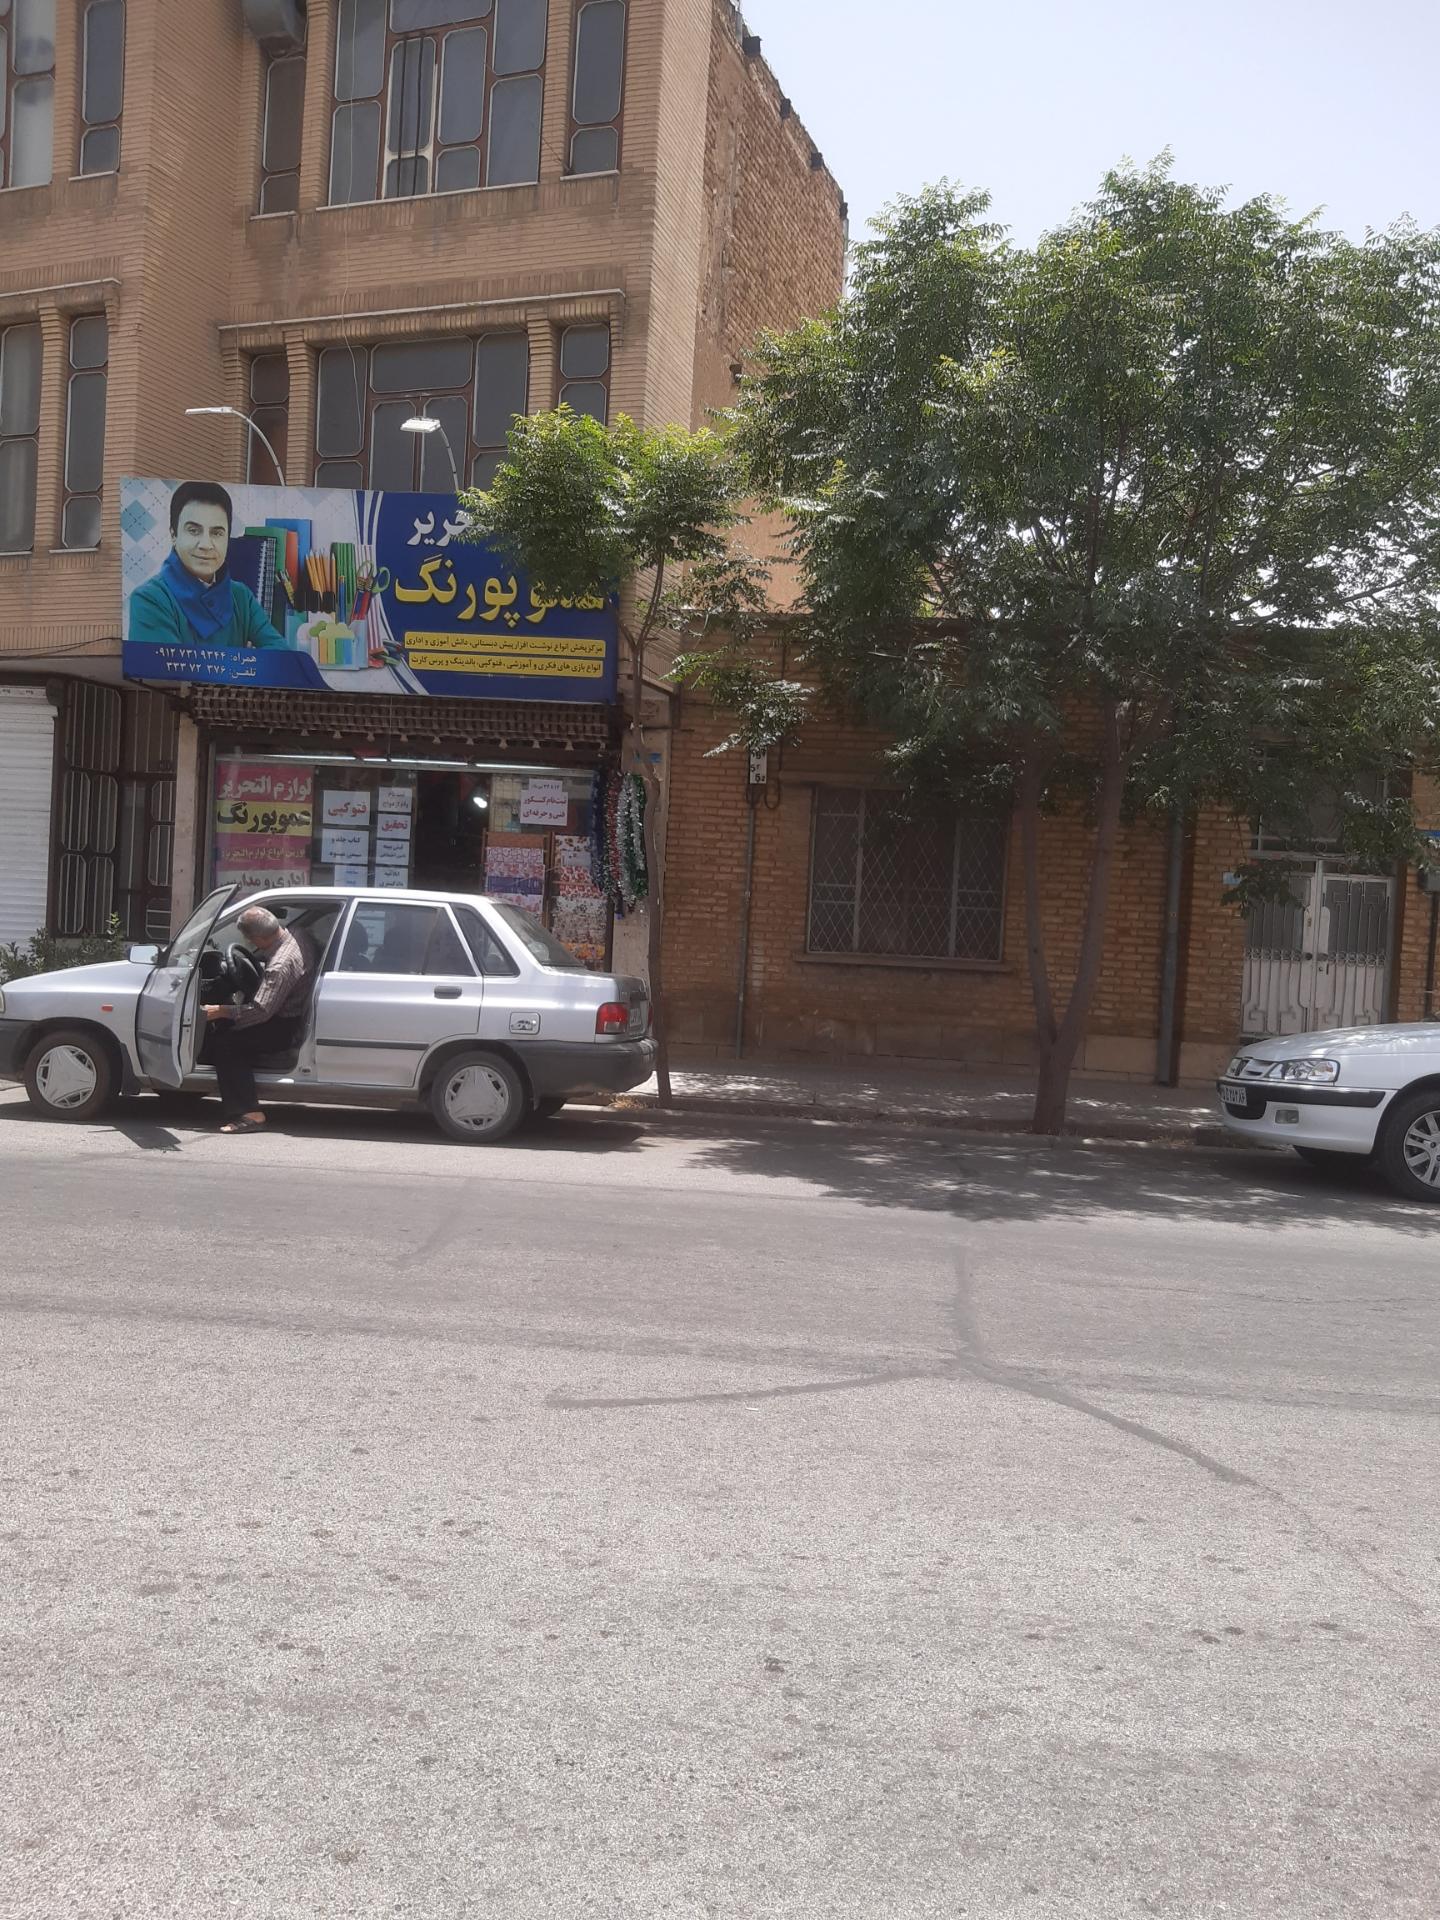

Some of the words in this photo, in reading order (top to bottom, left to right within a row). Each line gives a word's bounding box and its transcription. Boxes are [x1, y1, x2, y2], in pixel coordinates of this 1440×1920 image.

[395, 553, 520, 627] پورنگ
[155, 647, 176, 657] ۰۹۱۲
[179, 648, 198, 660] ۷۳۱
[218, 775, 272, 799] التحریر
[273, 776, 312, 801] لوازم
[381, 821, 409, 832] تحقیق
